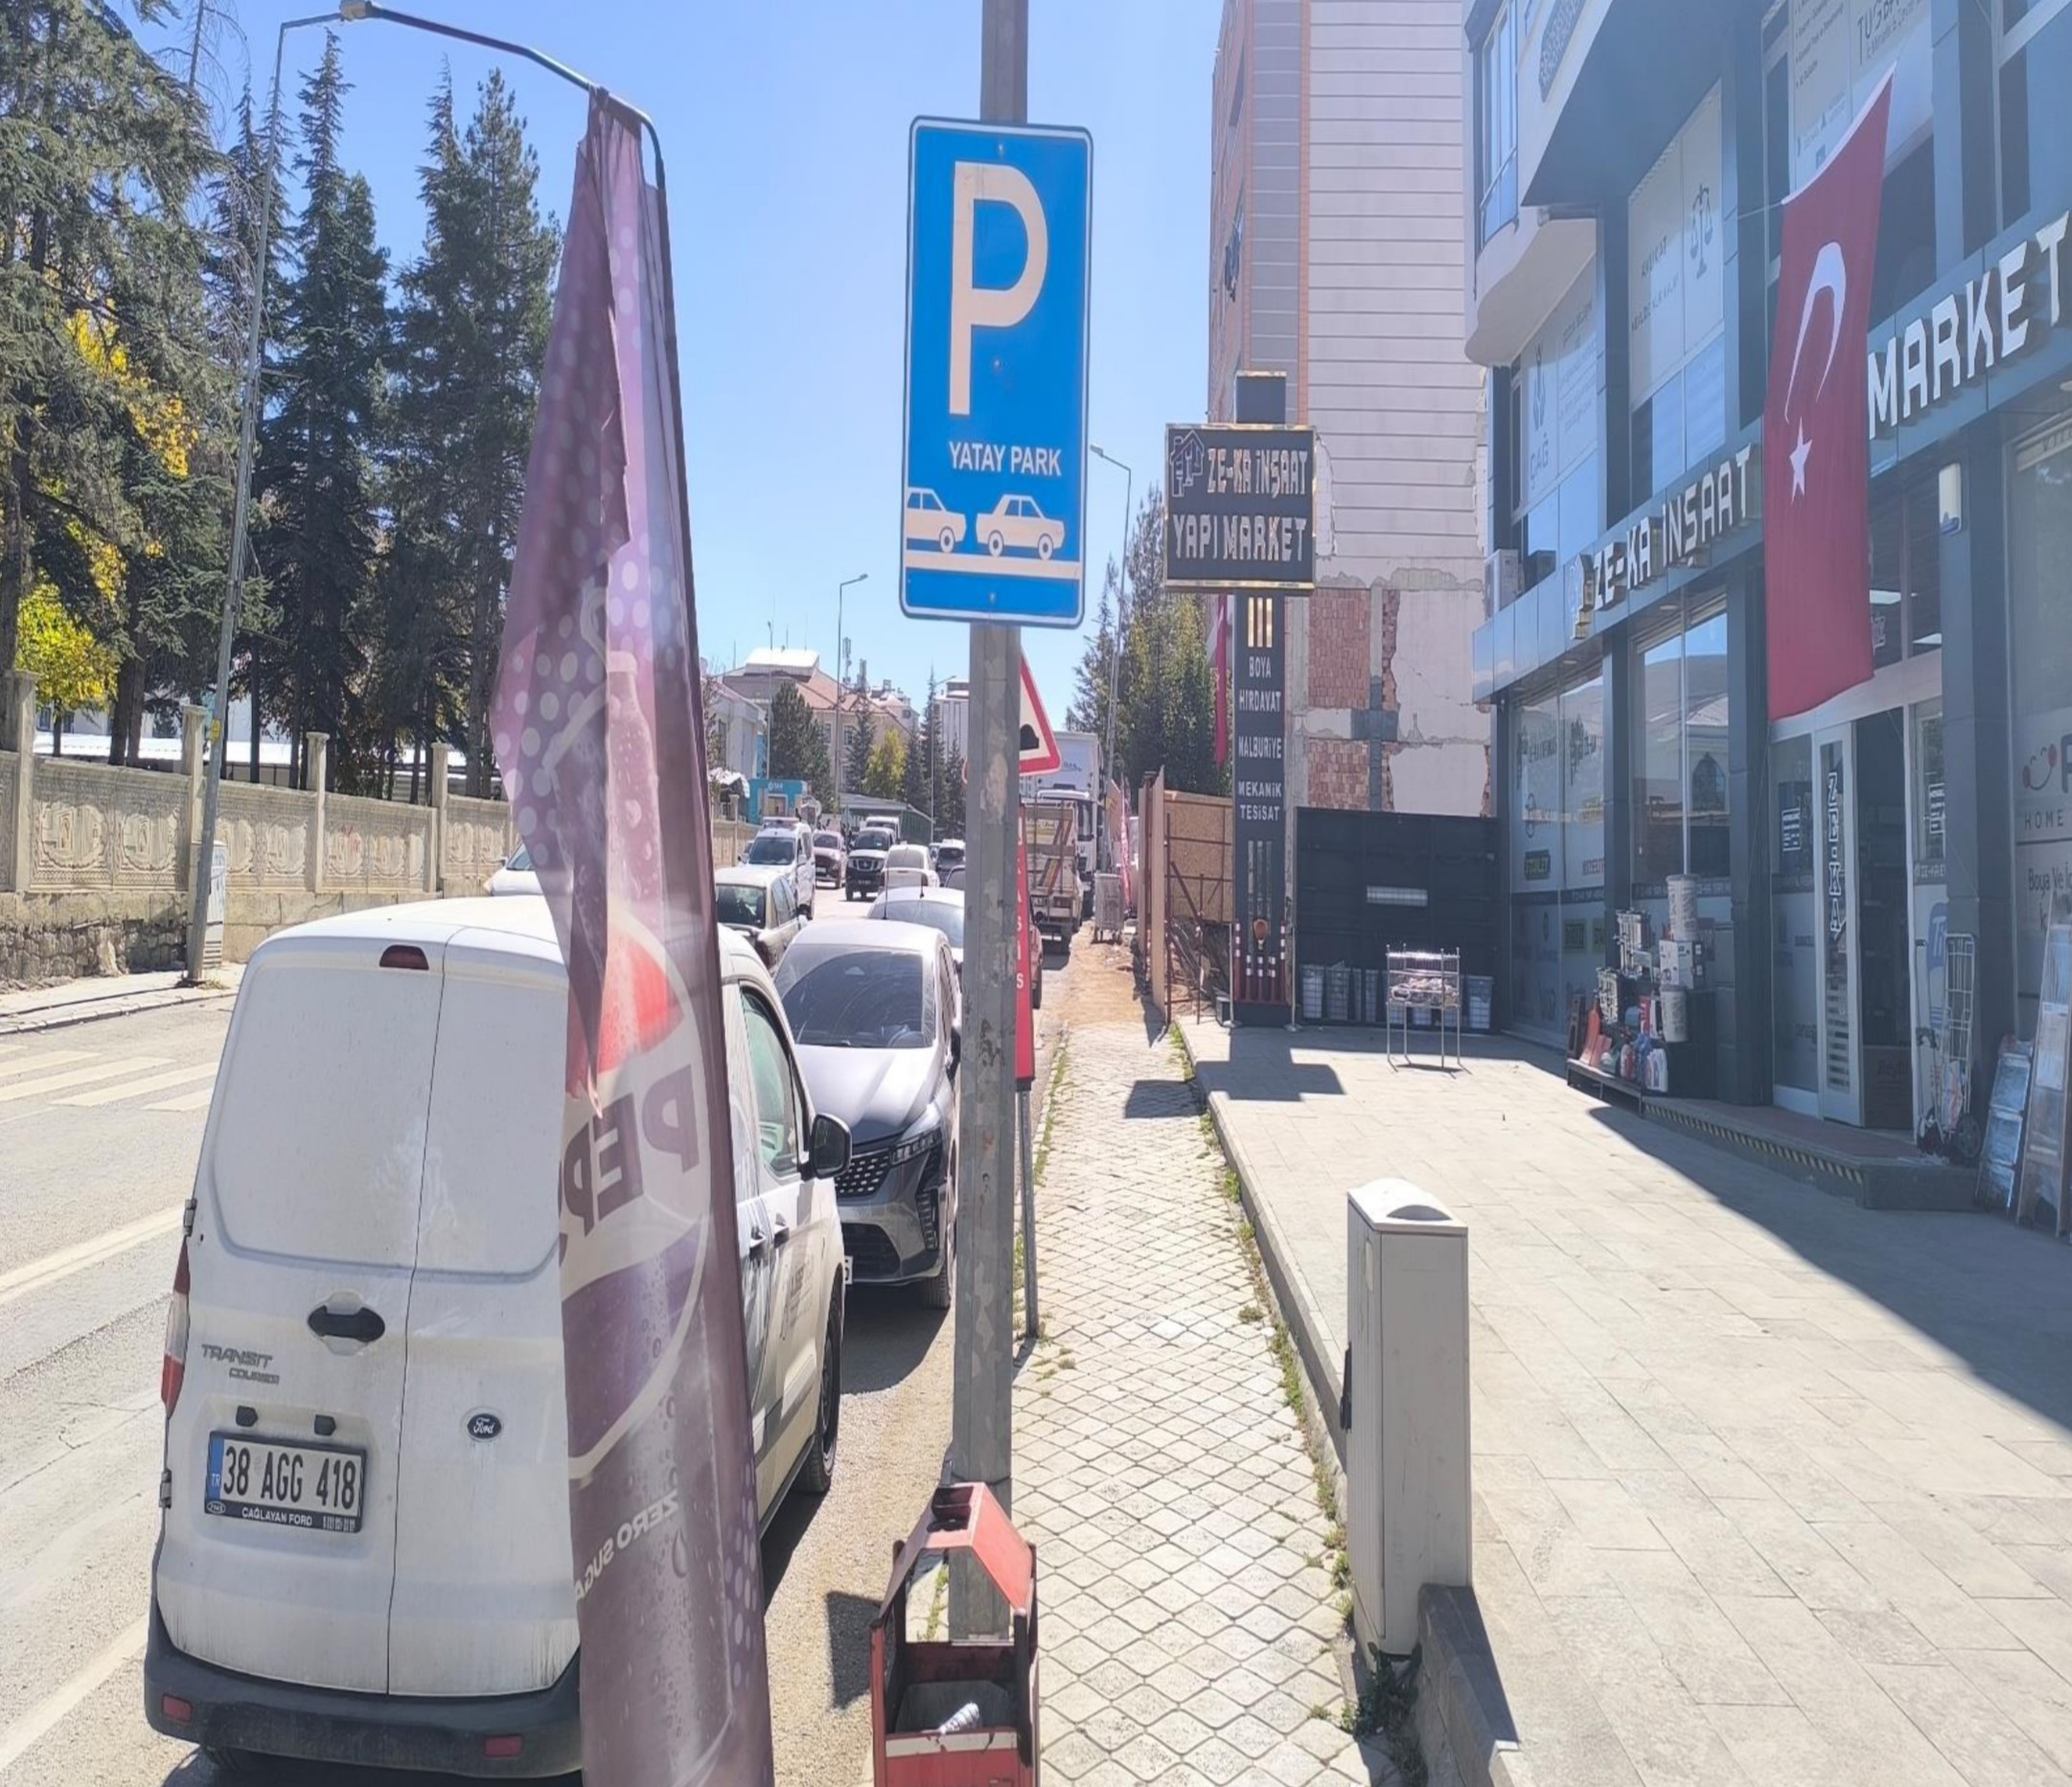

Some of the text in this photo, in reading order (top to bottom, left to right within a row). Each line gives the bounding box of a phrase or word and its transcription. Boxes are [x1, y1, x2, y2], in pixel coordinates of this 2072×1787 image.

[949, 161, 1048, 416] P
[1867, 211, 2071, 440] MARKET
[948, 441, 1062, 477] YATAY PARK
[1207, 447, 1308, 498] ZE-KA İNŞAAT
[1173, 514, 1307, 562] YAPI MARKET
[1594, 516, 1651, 612] ZE-KA
[1249, 656, 1272, 679] BOYA
[1239, 689, 1281, 713] HIRDAVAT
[1238, 781, 1282, 798] MEKANİK
[1240, 804, 1280, 821] TESİSAT
[2024, 809, 2064, 830] HOME
[2028, 867, 2050, 899] Boya
[201, 1343, 273, 1369] TRANSIT
[229, 1367, 280, 1386] COURIER
[472, 1417, 495, 1434] Ford
[211, 1474, 221, 1487] TR
[223, 1446, 357, 1510] 38 AGG 418
[288, 1514, 313, 1526] FORD
